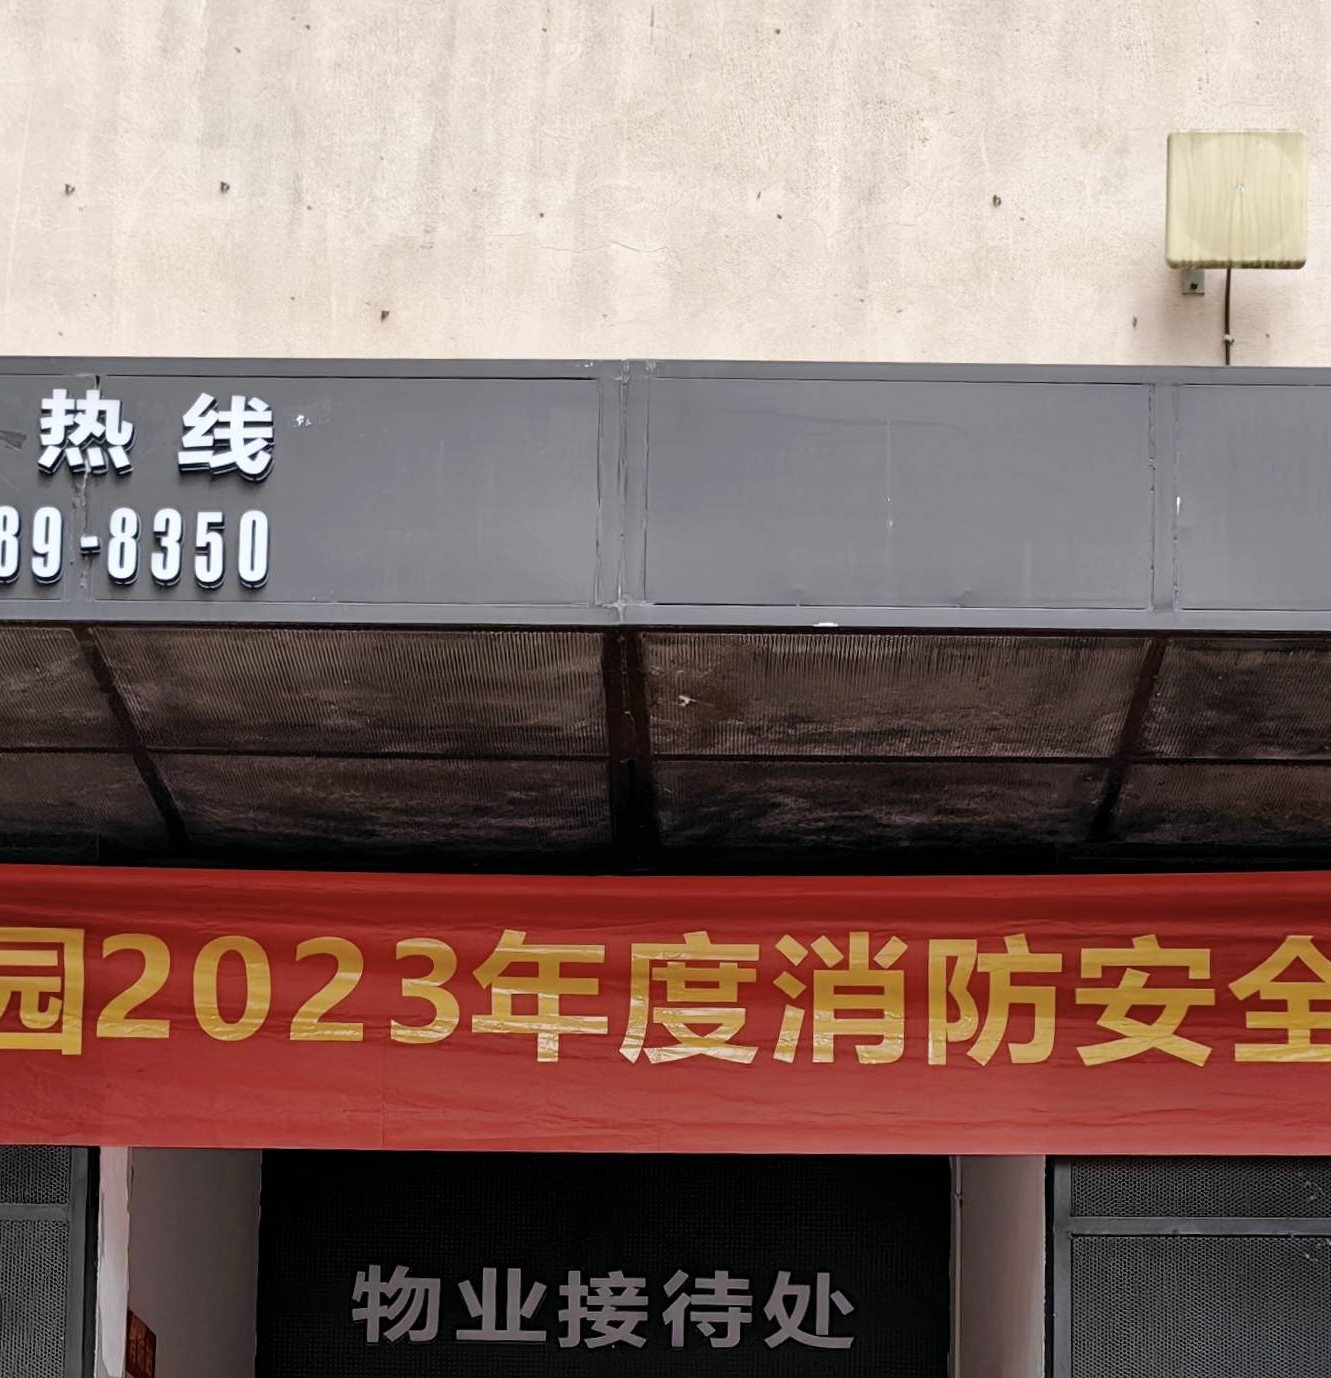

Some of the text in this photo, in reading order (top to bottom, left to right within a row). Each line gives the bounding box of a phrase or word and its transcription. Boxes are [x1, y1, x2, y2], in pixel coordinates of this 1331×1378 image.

[350, 1264, 856, 1350] 物业接待处
